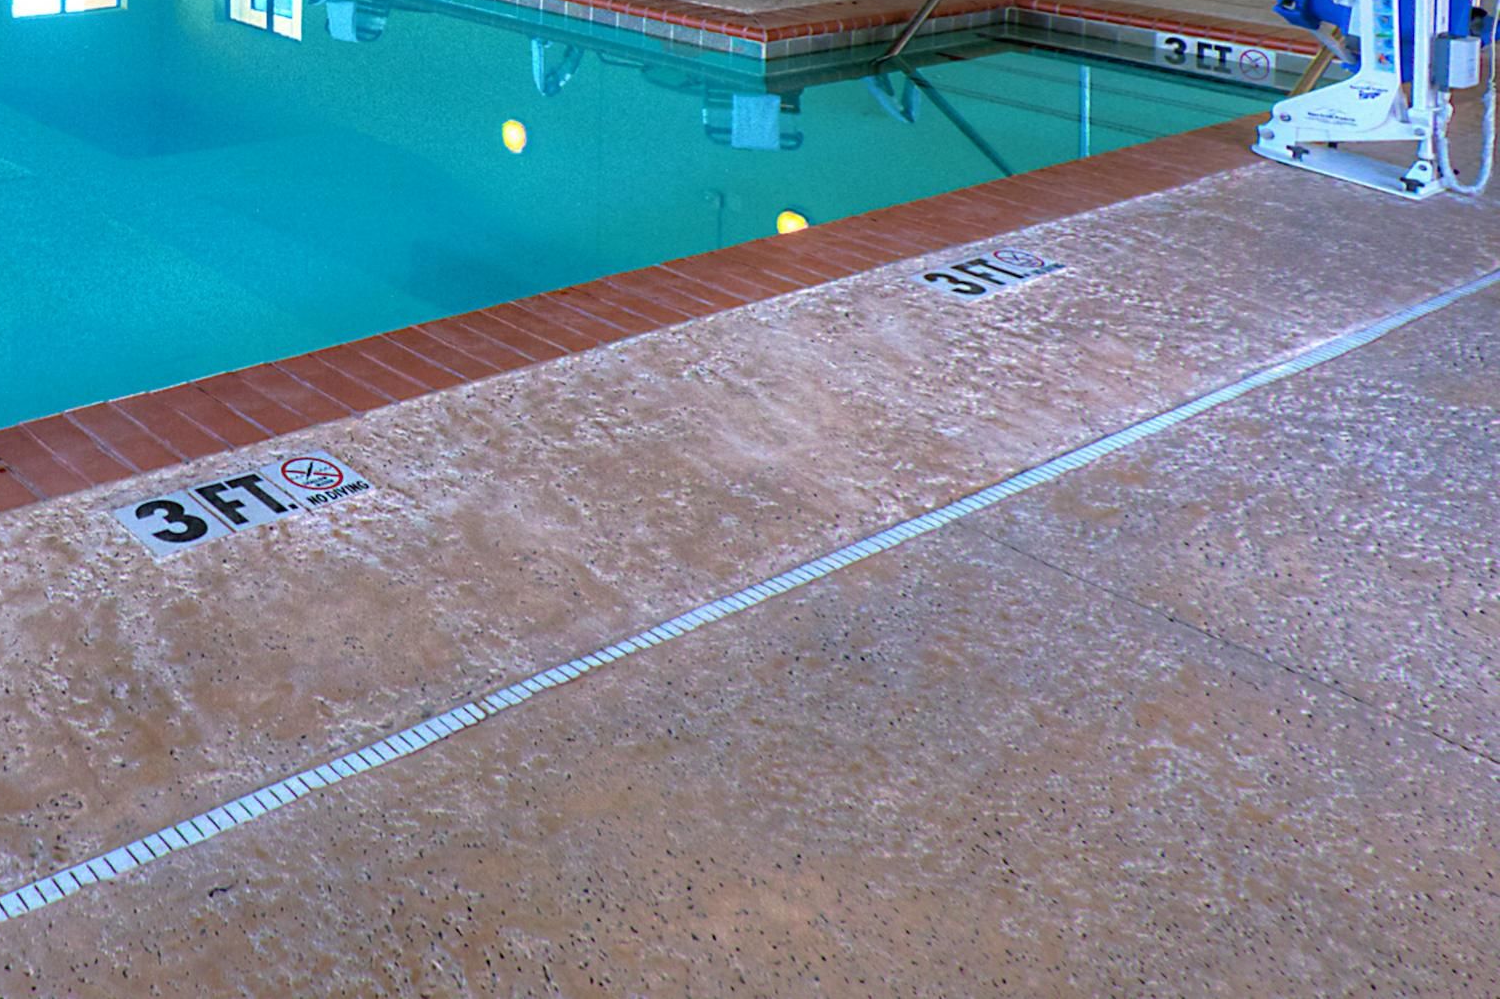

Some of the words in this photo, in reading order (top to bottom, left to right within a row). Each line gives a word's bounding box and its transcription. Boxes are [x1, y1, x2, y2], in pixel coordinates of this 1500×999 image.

[923, 272, 987, 295] 3
[306, 493, 328, 506] NO
[326, 480, 370, 500] DIVING
[135, 499, 208, 543] 3
[195, 473, 299, 525] FT.
